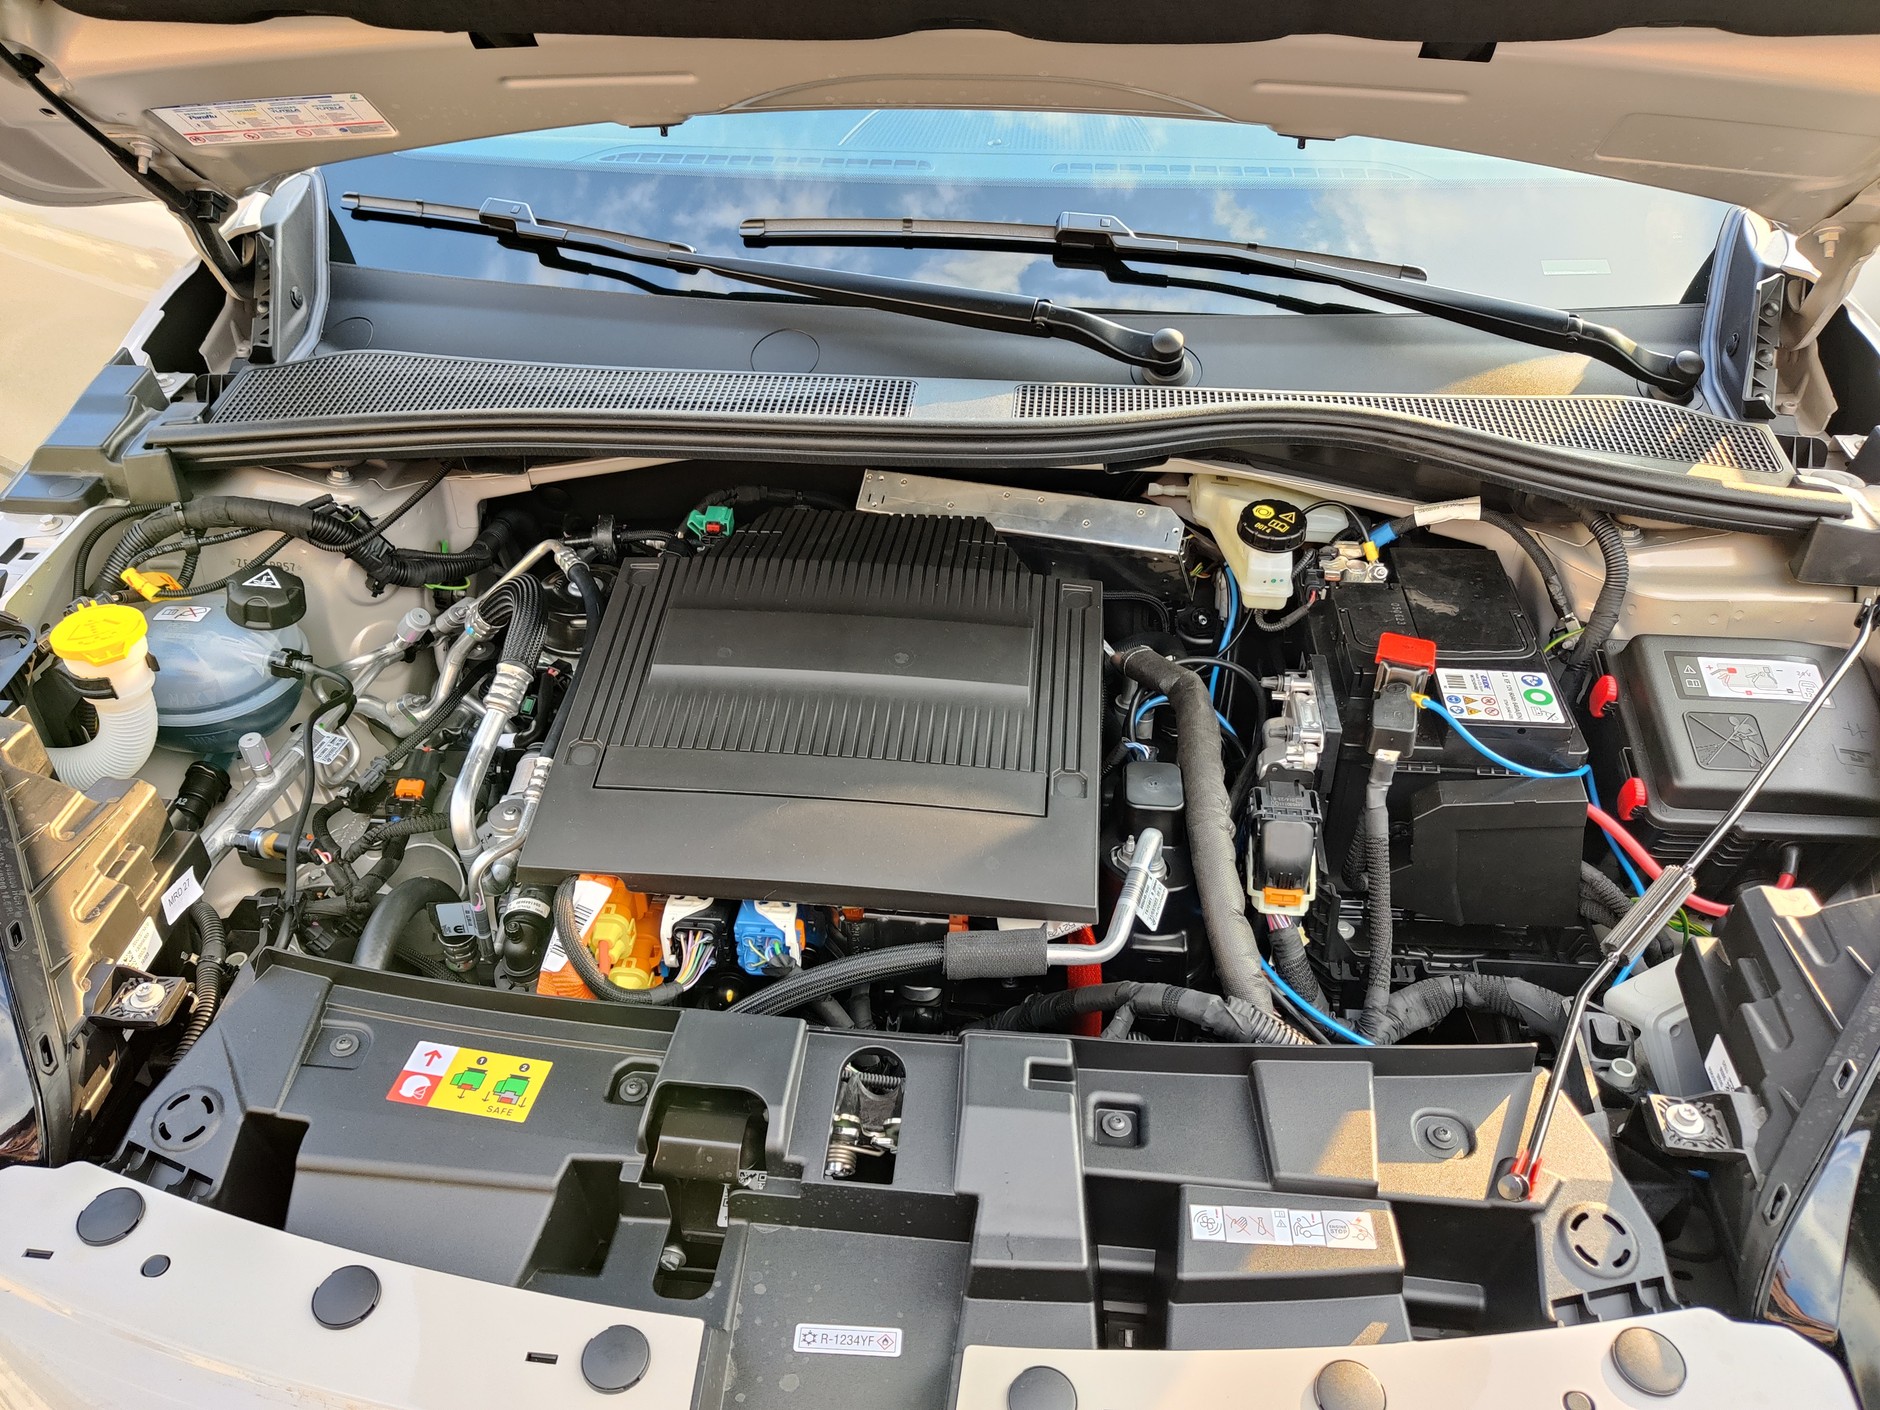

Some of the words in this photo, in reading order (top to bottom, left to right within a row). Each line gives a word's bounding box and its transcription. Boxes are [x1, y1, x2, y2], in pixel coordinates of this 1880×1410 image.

[1254, 522, 1266, 531] DOT
[175, 797, 188, 806] A2
[167, 886, 183, 908] MRD
[182, 877, 191, 892] 27
[486, 1105, 514, 1117] SAFE
[820, 1333, 875, 1347] R-1234YF
